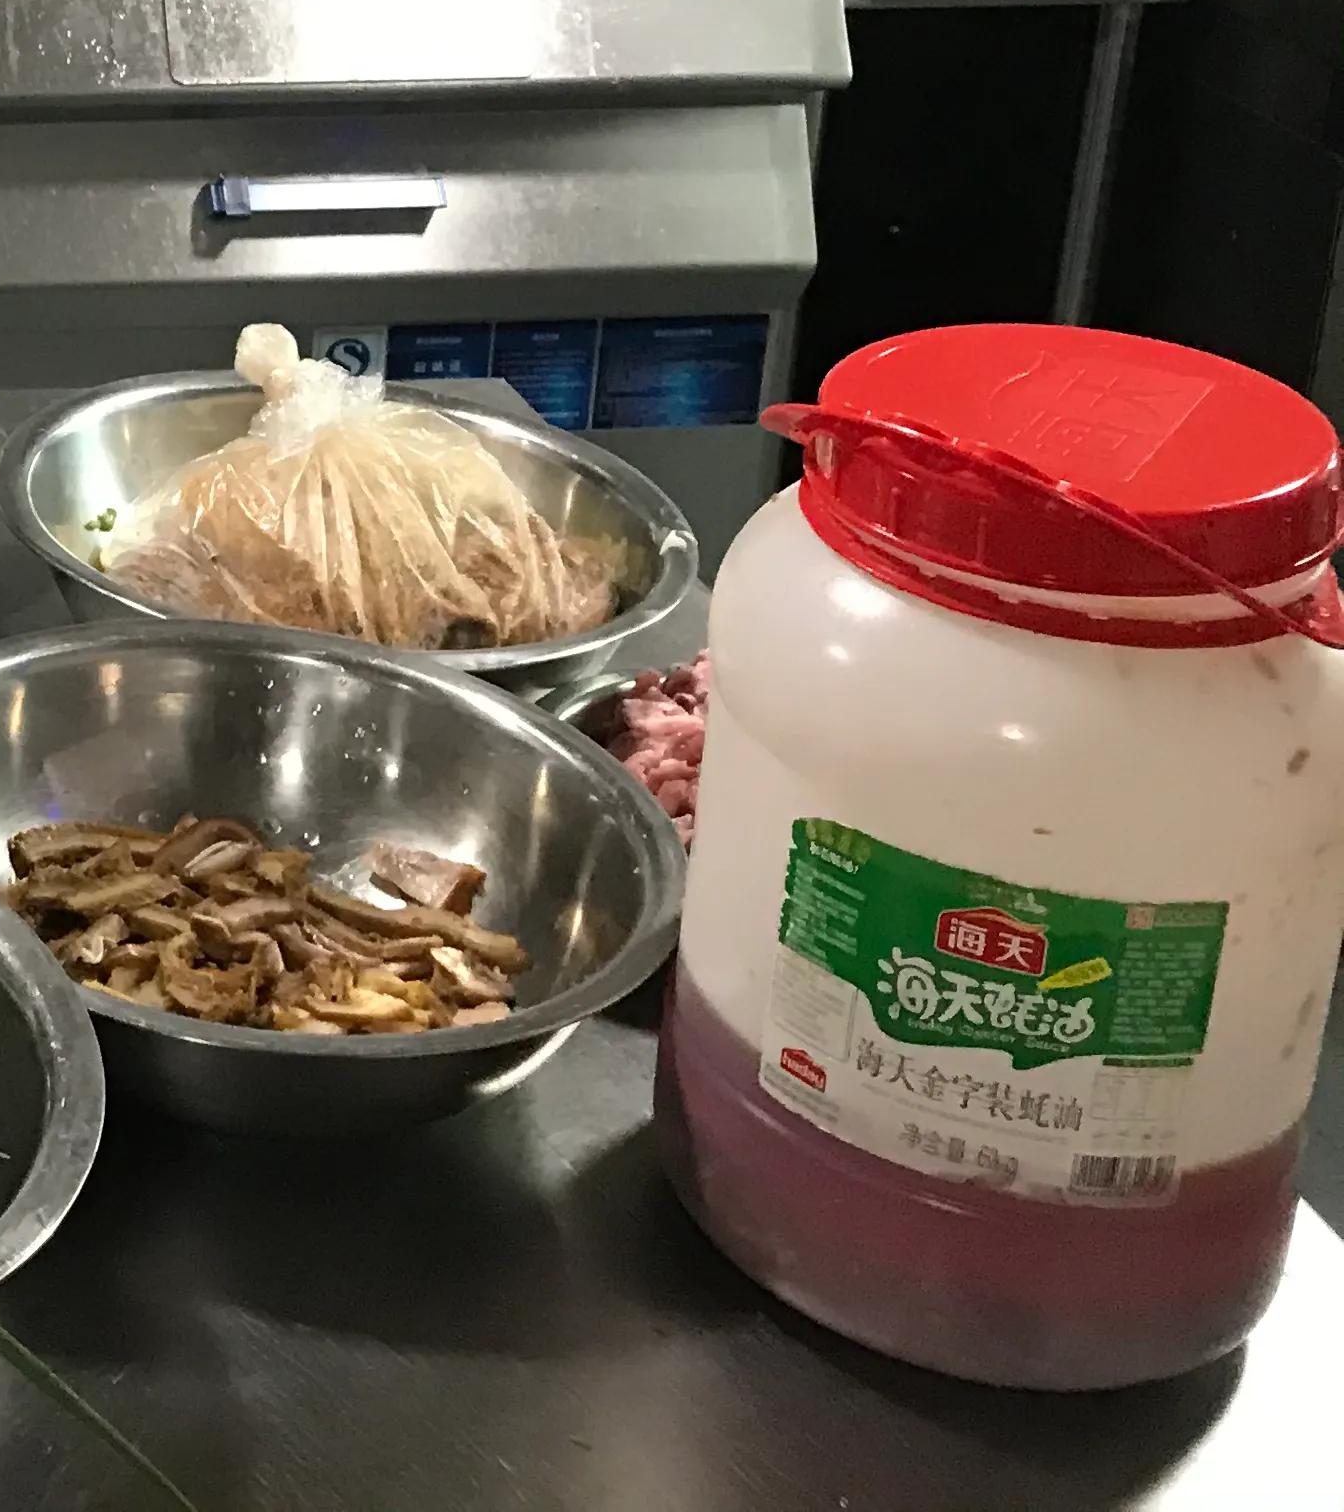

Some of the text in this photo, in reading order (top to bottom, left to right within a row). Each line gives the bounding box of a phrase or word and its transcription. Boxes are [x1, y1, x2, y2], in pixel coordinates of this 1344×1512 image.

[948, 917, 1034, 968] 海天
[876, 946, 1096, 1044] 海天蚝油
[857, 1038, 1084, 1131] 海天金字装蚝油
